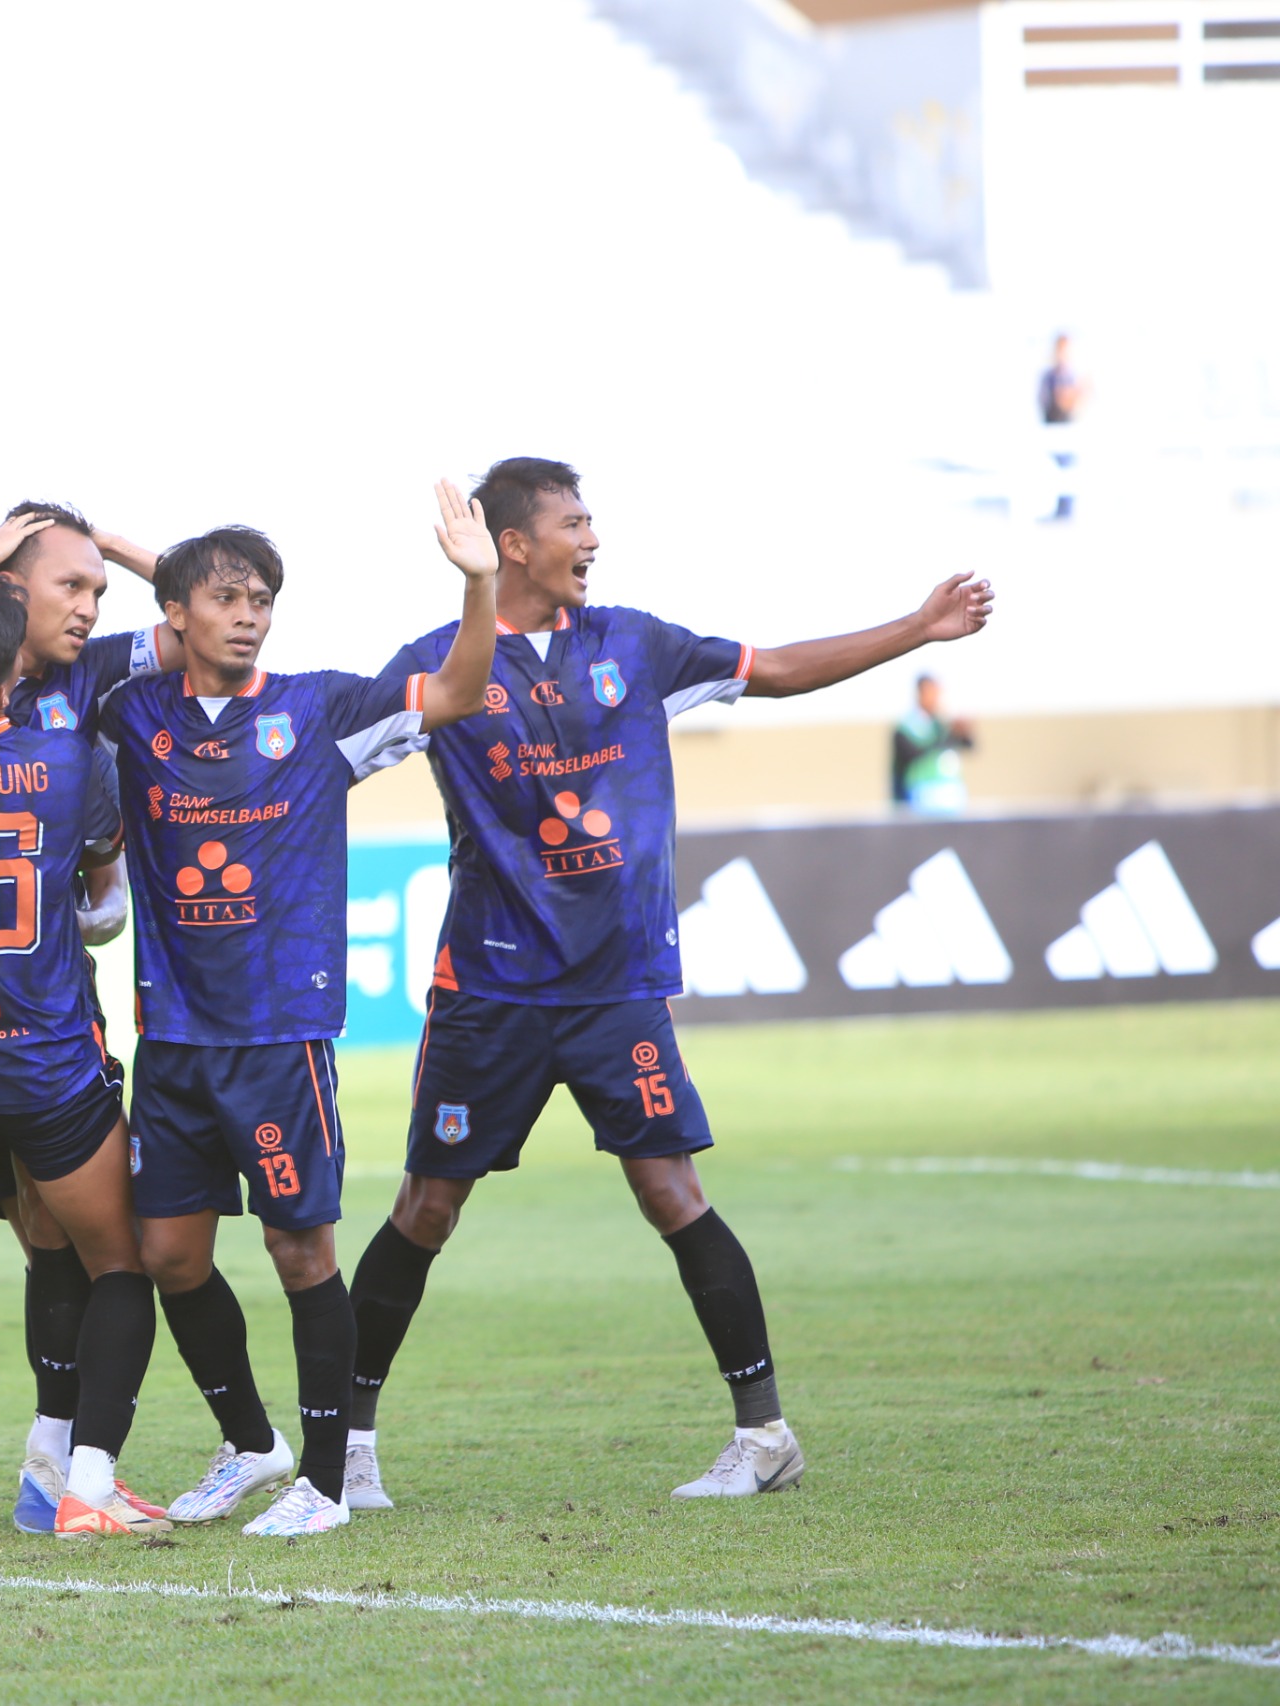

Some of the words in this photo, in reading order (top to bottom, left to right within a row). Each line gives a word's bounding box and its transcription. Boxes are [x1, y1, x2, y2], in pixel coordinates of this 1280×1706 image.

[517, 742, 557, 759] BANK
[519, 744, 625, 776] SUMSELBABEL
[169, 793, 214, 809] BANK
[541, 845, 623, 873] TITAN
[177, 902, 256, 921] TITAN
[633, 1073, 675, 1119] 15
[258, 1153, 301, 1198] 13
[721, 1358, 766, 1380] XTEN
[298, 1405, 338, 1418] TEN
